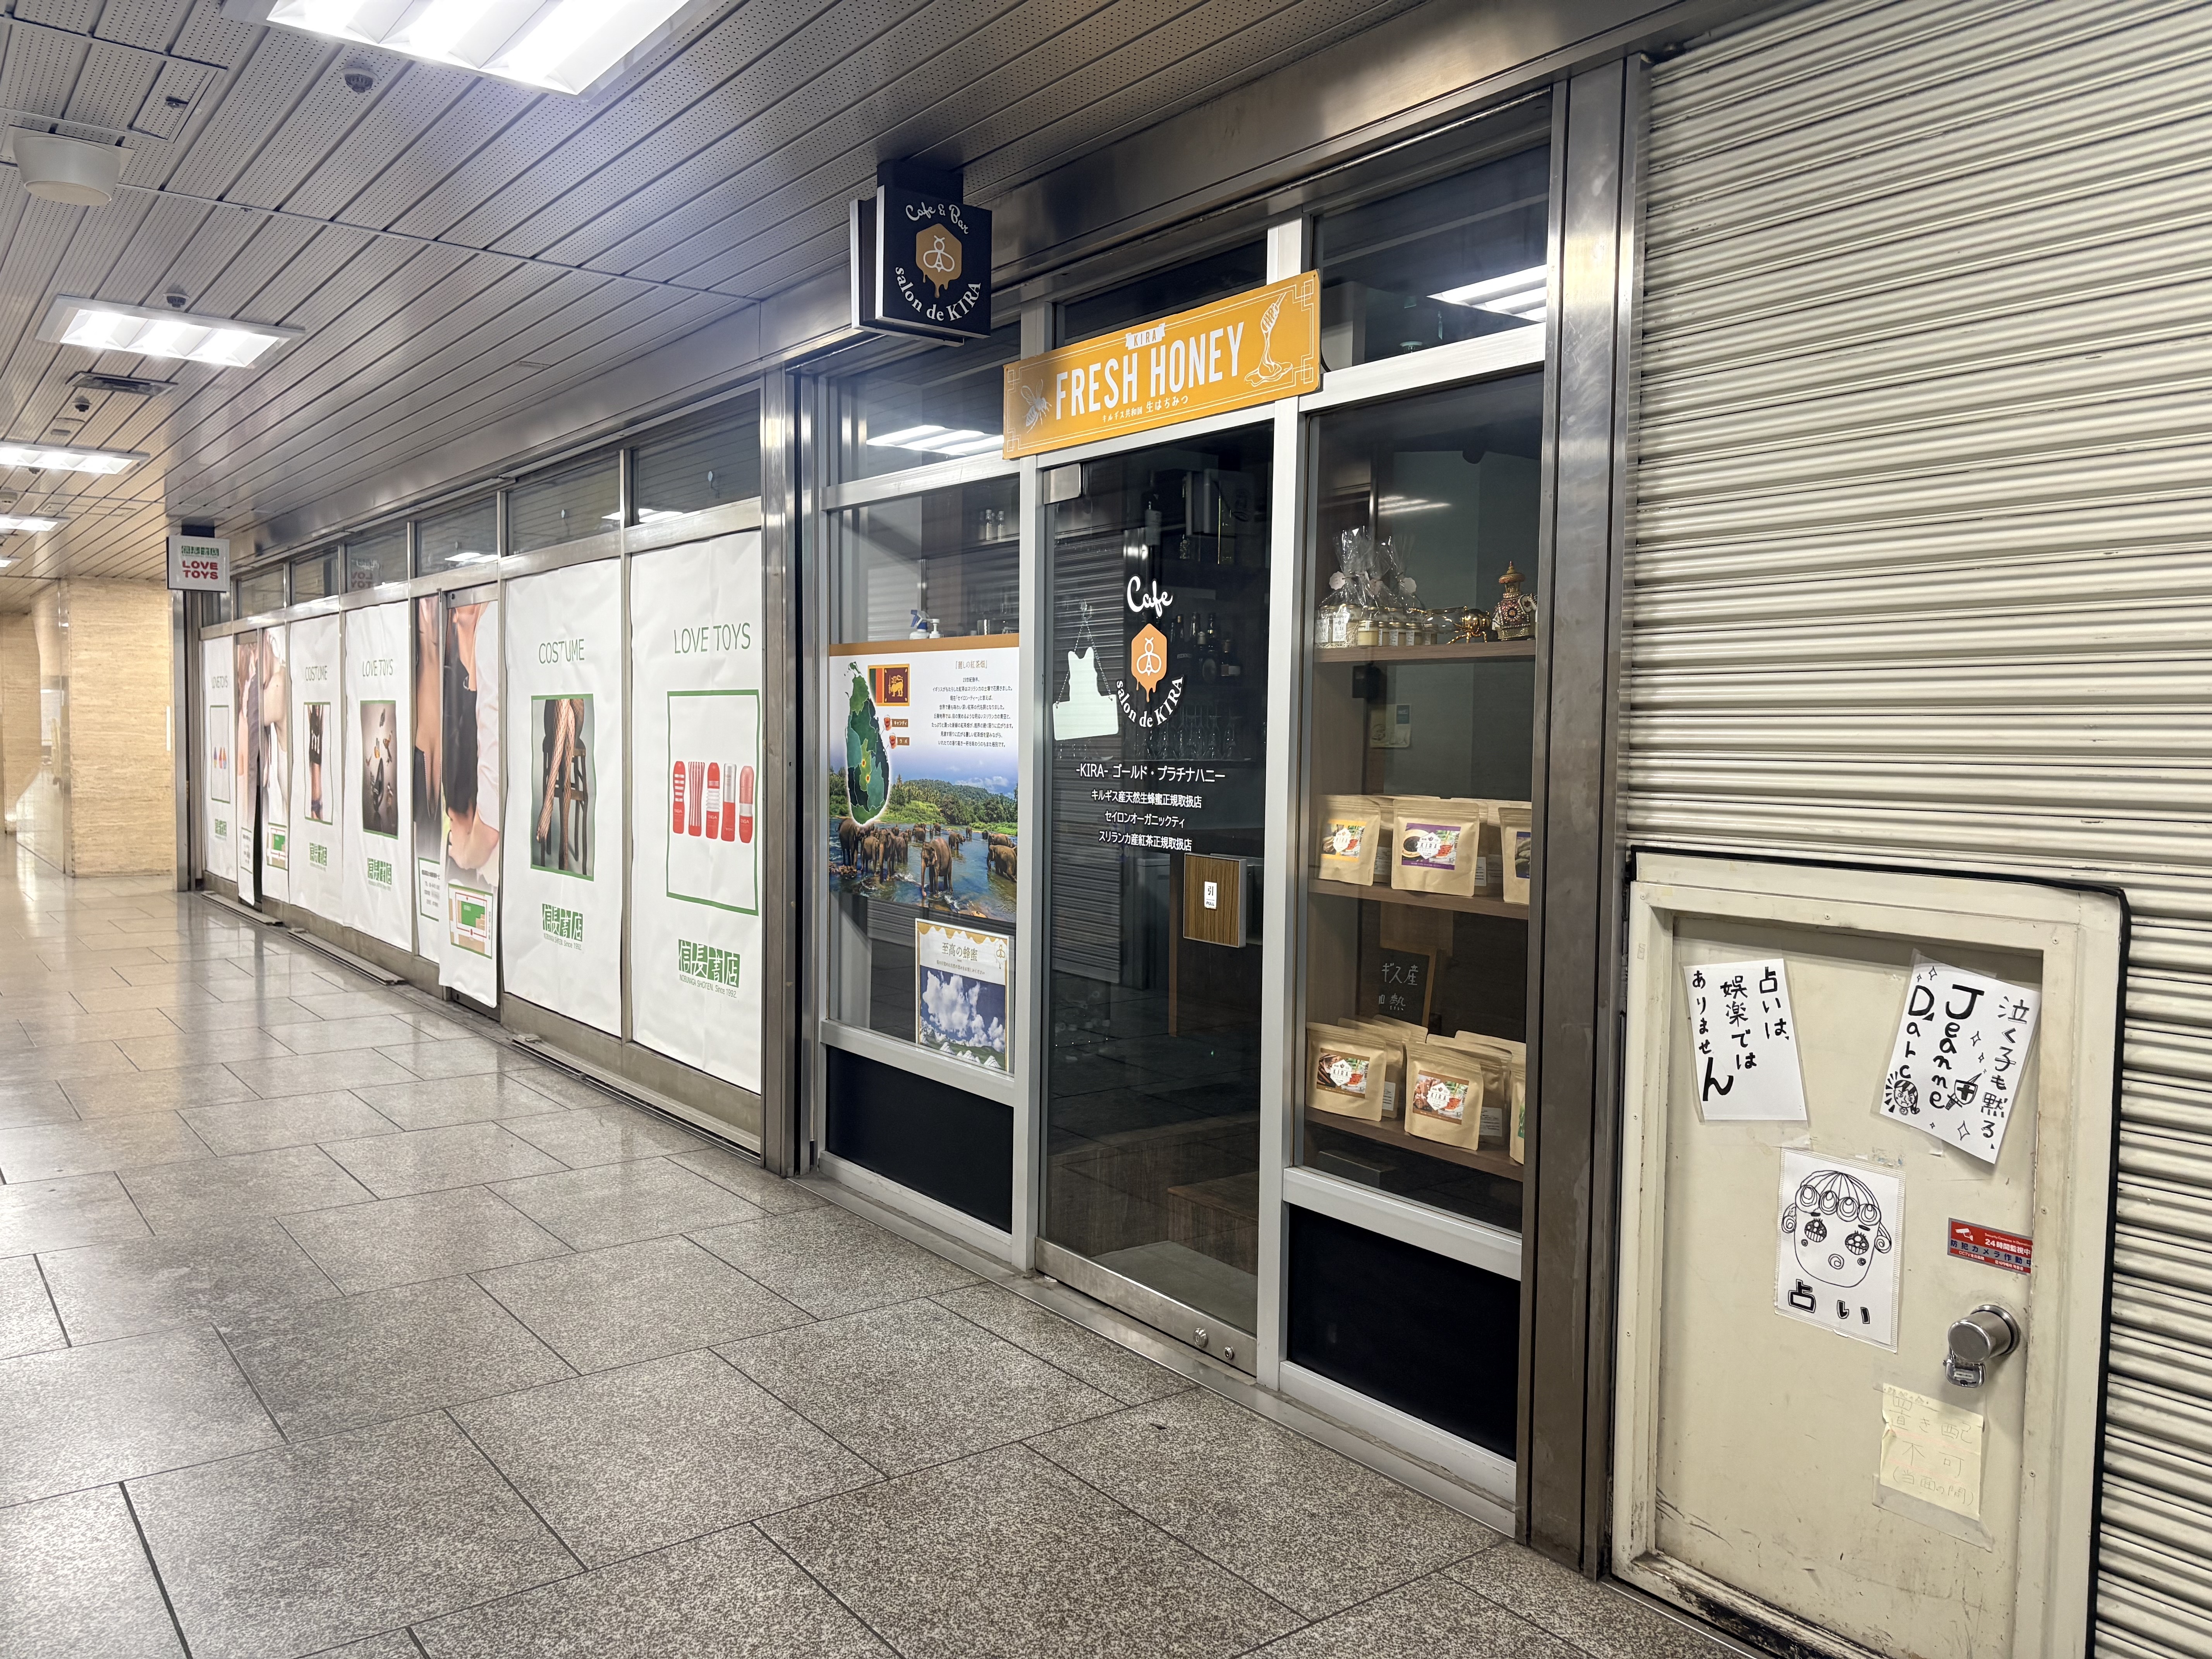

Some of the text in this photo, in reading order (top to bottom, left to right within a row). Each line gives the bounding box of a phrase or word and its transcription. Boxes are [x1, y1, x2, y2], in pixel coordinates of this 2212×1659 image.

[905, 202, 969, 234] Cafe & Bar
[895, 267, 981, 321] salon de KIRA
[1133, 330, 1157, 347] KIRA
[1056, 322, 1244, 420] FRESH HONEY
[1102, 395, 1188, 422] キルギス共和国 生はちみつ
[182, 560, 218, 570] LOVE
[183, 570, 218, 579] TOYS
[1127, 576, 1173, 617] Cafe
[674, 623, 750, 654] LOVE TOYS
[539, 639, 584, 664] COSTUME
[305, 666, 327, 681] COSTUME
[362, 659, 393, 677] LOVE TOYS
[1116, 676, 1183, 728] salon de KIRA
[1076, 763, 1225, 782] -KIRA- ゴールド・プラチナハニー
[1091, 789, 1202, 809] キルギス産天然生蜂蜜正規取扱店
[1105, 811, 1185, 828] セイロンオーガニックティ
[1099, 831, 1192, 852] スリランカ産紅茶正規取扱店
[1208, 886, 1214, 896] 引
[678, 939, 740, 988] 信長書店
[942, 943, 978, 961] 至高の蜂蜜
[715, 985, 725, 994] Since
[726, 989, 737, 998] 1992
[1759, 967, 1789, 1041] 占いは、
[1720, 975, 1757, 1070] 娯楽では
[1692, 970, 1734, 1101] ありません
[1929, 984, 1985, 1109] Jeanne
[1431, 1092, 1446, 1101] KIRA
[1985, 1238, 2031, 1256] 24時間監視中
[1788, 1279, 1870, 1324] 占い
[1902, 1441, 1965, 1476] 不可
